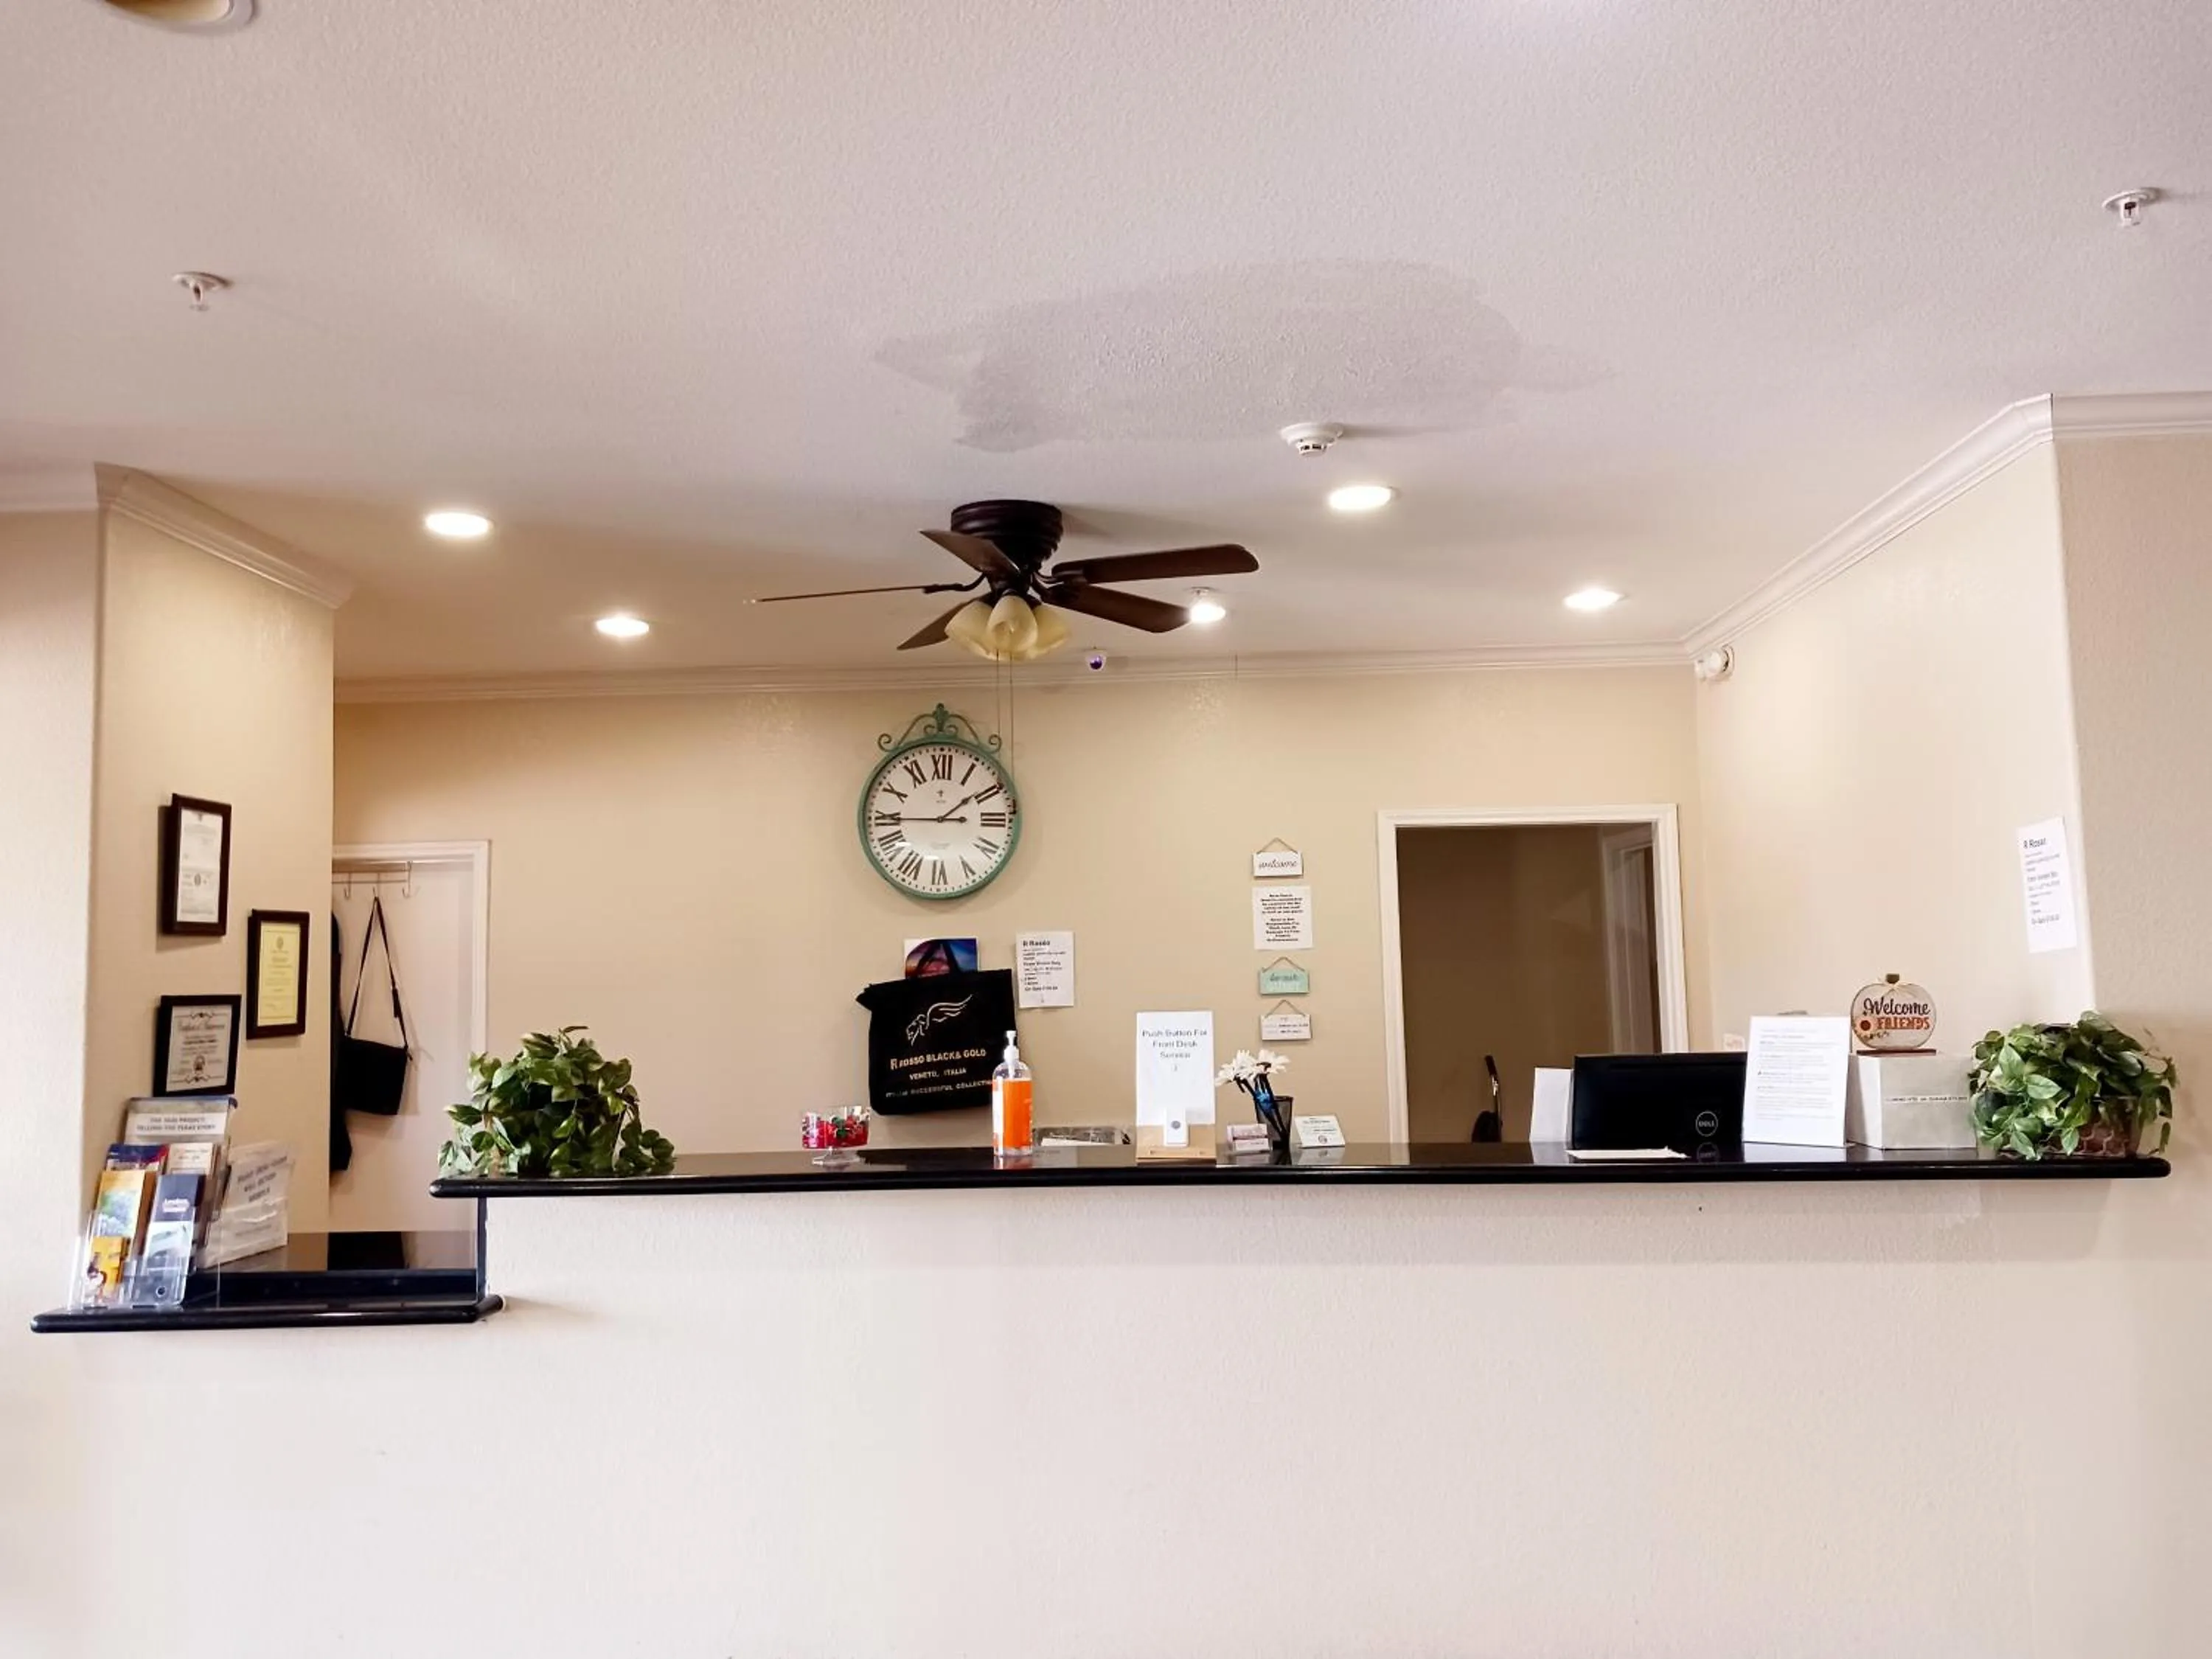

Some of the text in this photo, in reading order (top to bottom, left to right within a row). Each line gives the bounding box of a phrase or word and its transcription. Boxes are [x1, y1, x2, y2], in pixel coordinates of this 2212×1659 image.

[903, 759, 927, 788] XI
[931, 754, 953, 781] XII
[961, 762, 977, 786] I
[882, 782, 908, 804] X
[980, 812, 1006, 827] III
[897, 849, 924, 880] VII
[931, 860, 948, 885] VI
[959, 855, 976, 879] V
[1863, 996, 1930, 1015] Welcome
[1877, 1017, 1930, 1030] FRIENDS
[963, 1048, 987, 1058] GOLD
